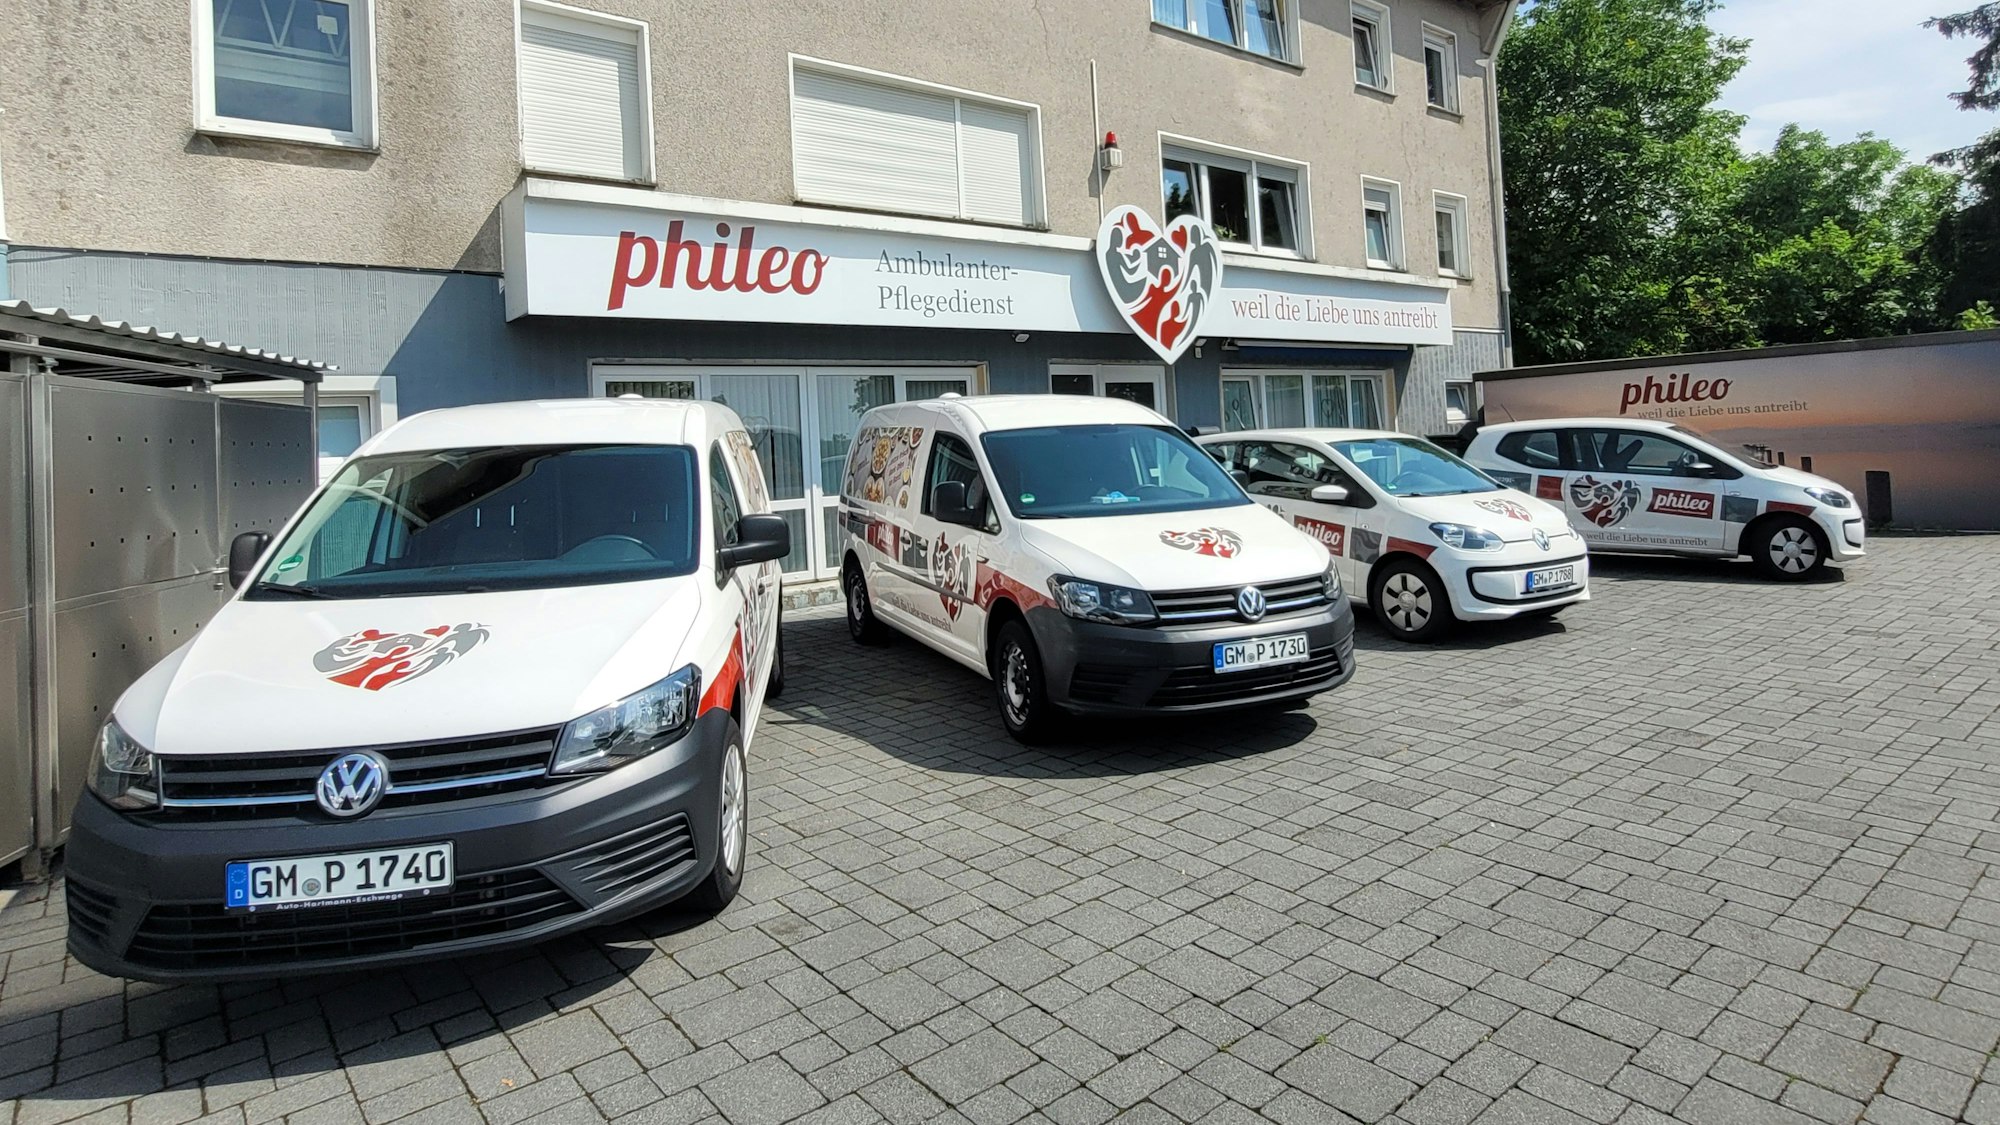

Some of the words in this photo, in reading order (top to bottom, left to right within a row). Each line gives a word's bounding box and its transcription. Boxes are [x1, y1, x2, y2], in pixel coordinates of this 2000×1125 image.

[606, 219, 830, 311] phileo
[875, 248, 1019, 282] Ambulanter-
[877, 284, 1015, 318] Pflegedienst
[1231, 294, 1270, 321] weil
[1274, 295, 1300, 322] die
[1305, 297, 1349, 325] Liebe
[1352, 308, 1380, 327] uns
[1383, 305, 1439, 330] antreibt
[1619, 372, 1733, 415] phileo
[1637, 407, 1662, 420] weil
[1666, 406, 1685, 418] die
[1689, 404, 1724, 416] Liebe
[1727, 406, 1750, 415] uns
[1753, 400, 1808, 413] antreibt
[1653, 492, 1711, 511] phileo
[1586, 532, 1604, 542] weil
[1606, 533, 1620, 542] die
[1623, 534, 1648, 543] Liebe
[1669, 536, 1708, 546] antreibt
[1534, 573, 1544, 586] GM
[1548, 572, 1554, 583] P
[1554, 568, 1572, 582] 1788
[1224, 646, 1246, 665] GM
[1256, 644, 1265, 660] P
[1270, 638, 1306, 658] 1730
[234, 888, 244, 899] D
[251, 864, 298, 899] GM
[325, 861, 345, 893] P
[356, 850, 446, 890] 1740
